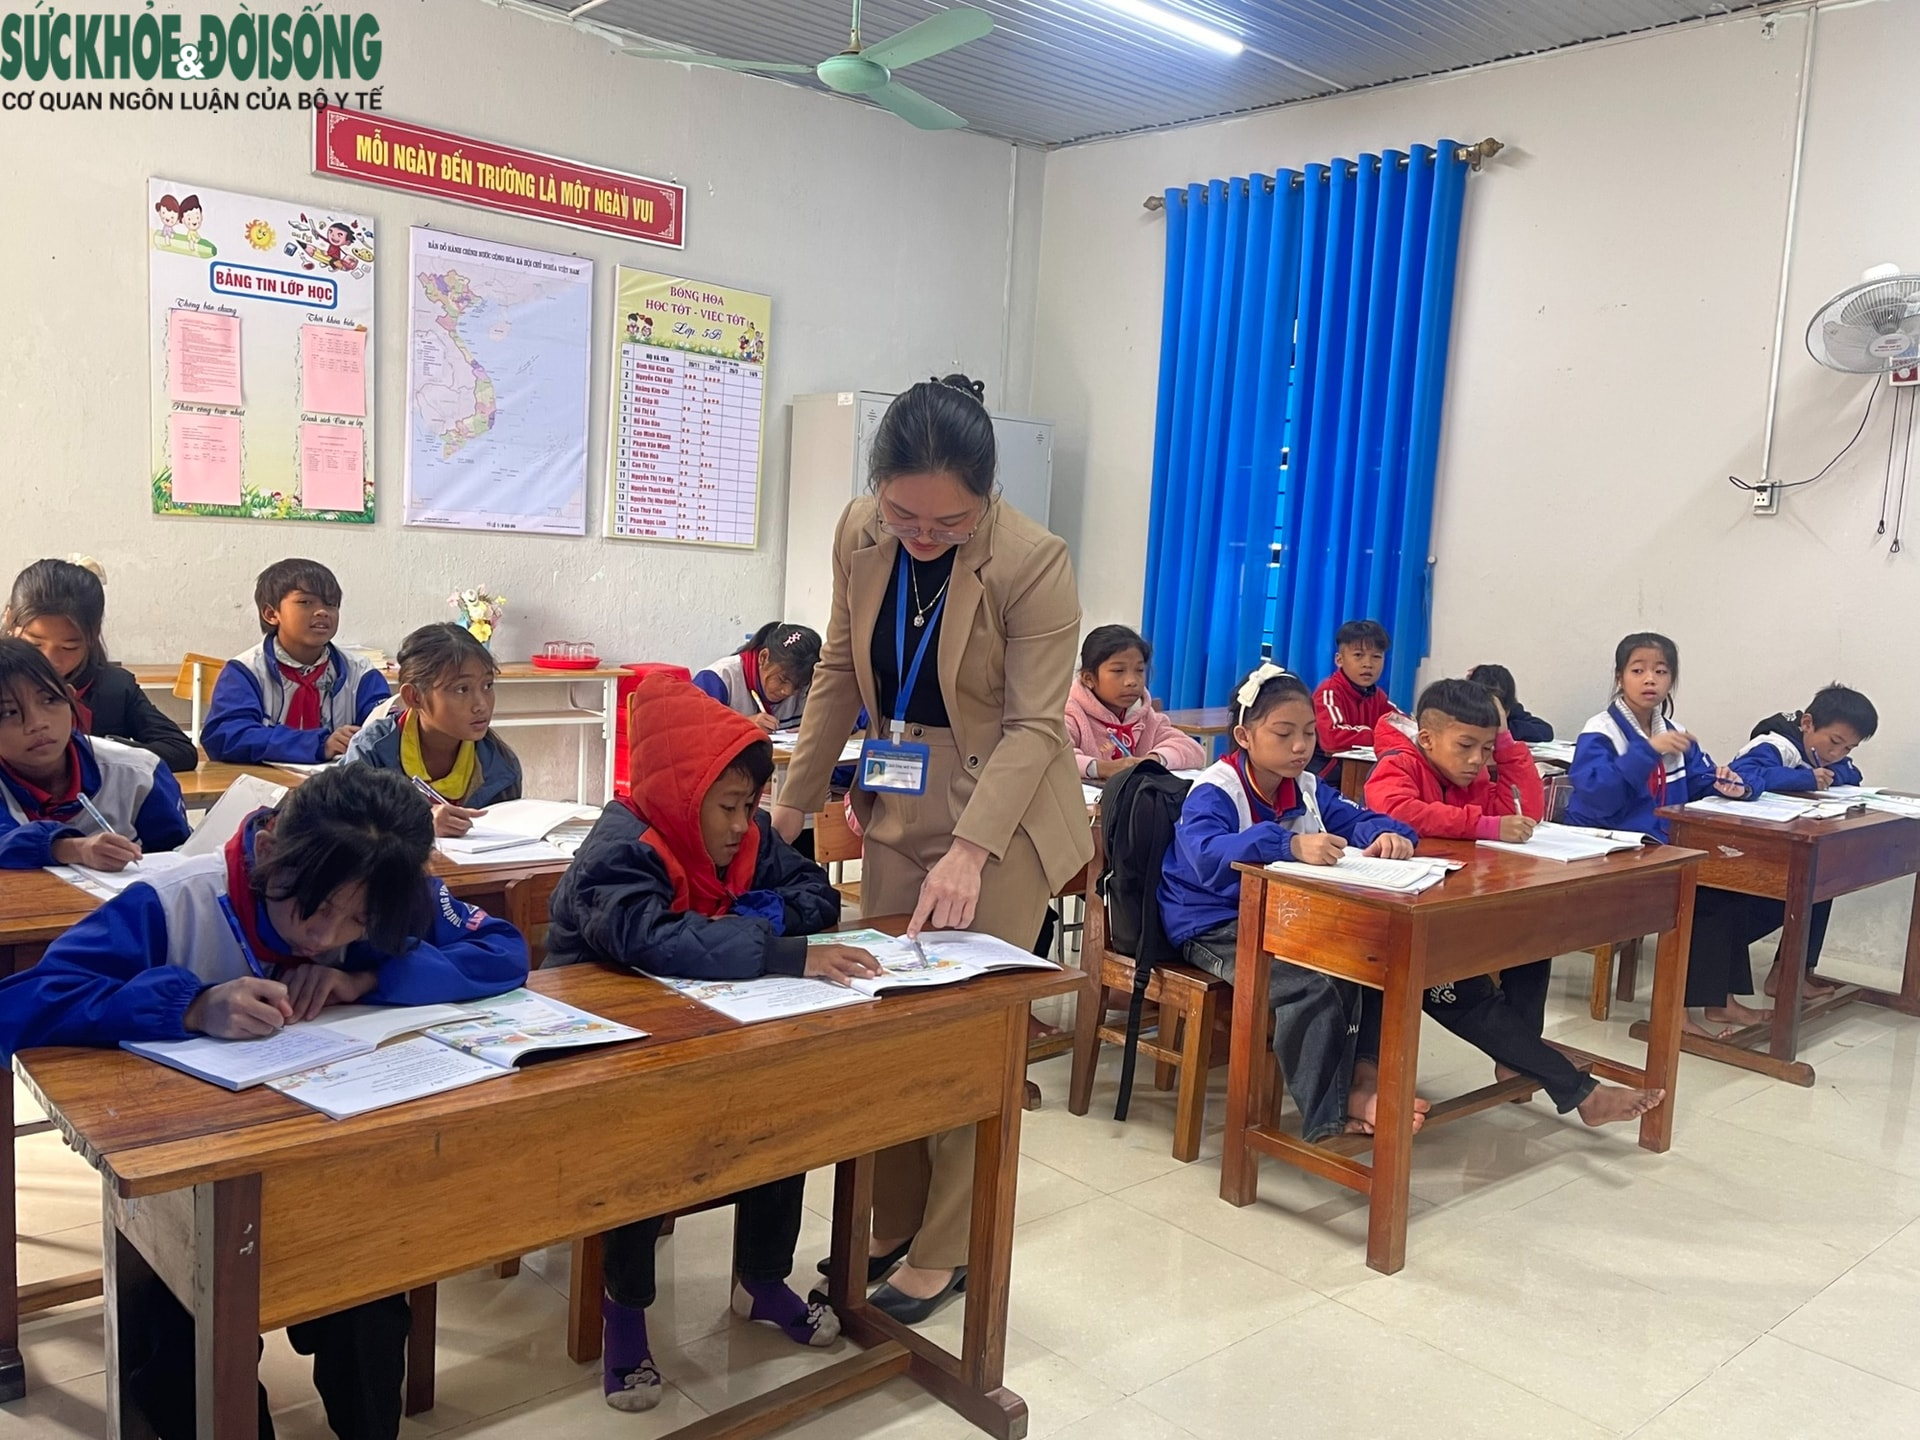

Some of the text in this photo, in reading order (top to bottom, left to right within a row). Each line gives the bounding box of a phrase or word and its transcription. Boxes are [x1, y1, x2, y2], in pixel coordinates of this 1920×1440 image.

[355, 128, 654, 224] MỖI NGÀY ĐẾN TRƯỜNG LÀ MỘT NGÀY VUI
[215, 268, 333, 303] BẢNG TIN LỚP HỌC
[701, 328, 723, 341] 5B
[440, 897, 463, 928] TRƯỜNG
